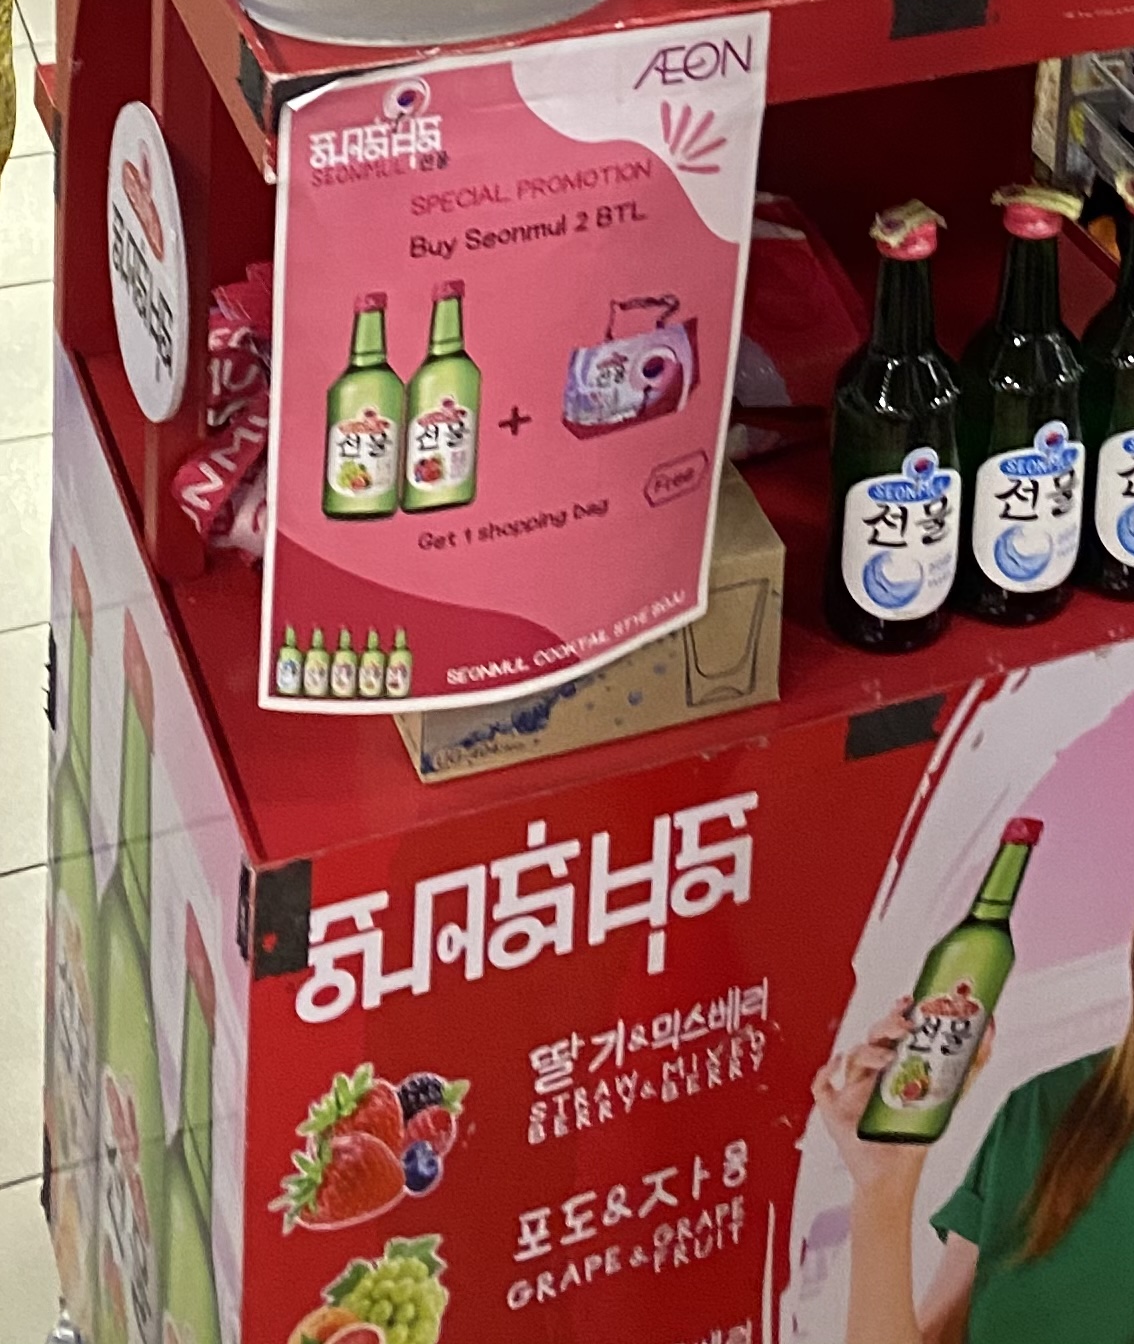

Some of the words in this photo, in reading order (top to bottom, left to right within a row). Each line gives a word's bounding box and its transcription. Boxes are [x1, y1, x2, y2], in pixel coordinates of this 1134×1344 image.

[410, 184, 508, 217] SPECIAL
[516, 158, 654, 200] PROMOTION
[409, 231, 457, 260] Buy
[464, 214, 568, 251] Seonmul
[573, 211, 589, 233] 2
[595, 199, 648, 230] BTL
[653, 468, 696, 493] Free
[418, 531, 457, 551] Get
[478, 510, 568, 542] shopping
[572, 498, 610, 521] bag
[506, 1244, 623, 1311] GRAPE
